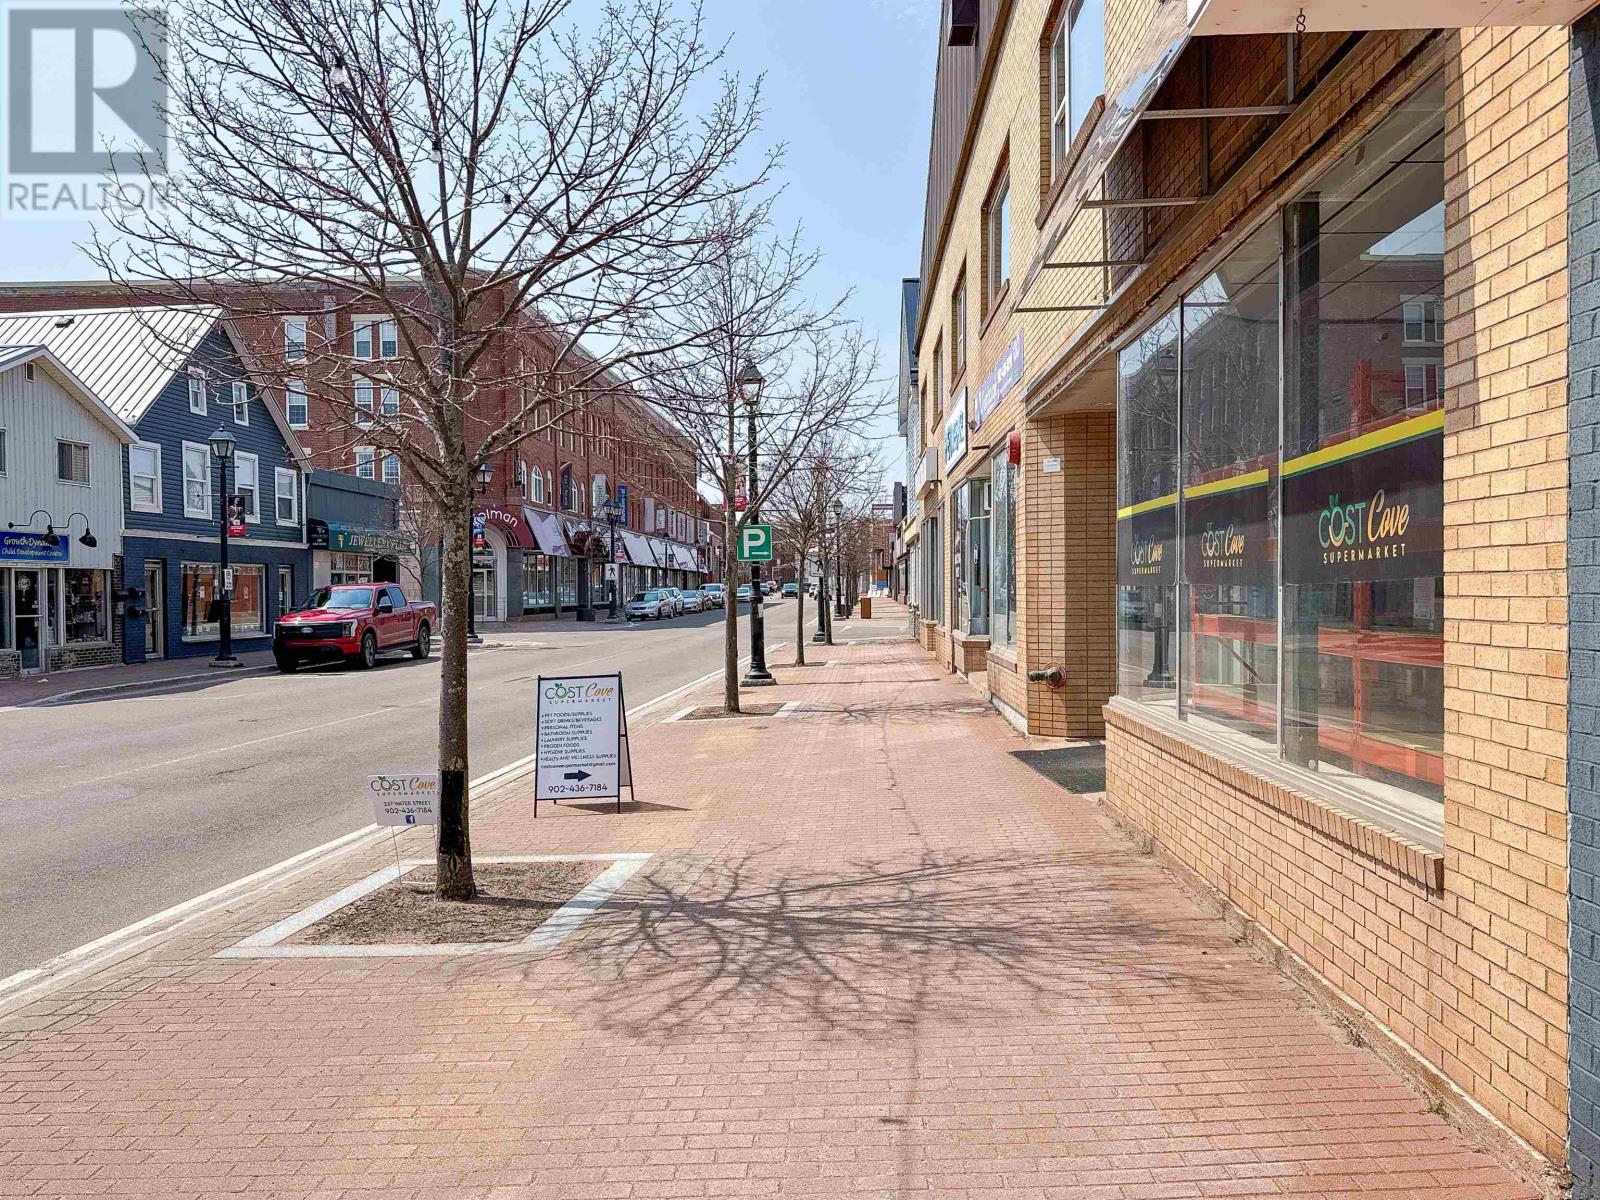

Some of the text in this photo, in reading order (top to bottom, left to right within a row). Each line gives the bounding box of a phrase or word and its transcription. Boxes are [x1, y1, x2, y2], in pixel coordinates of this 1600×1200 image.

[1319, 489, 1410, 548] COST Cove
[4, 537, 28, 545] Growth
[743, 528, 766, 558] P
[1201, 524, 1245, 557] COST Cove
[1130, 538, 1148, 565] COST
[1323, 543, 1406, 564] SUPERMARKET
[1131, 565, 1161, 575] SUPERMARKET
[1203, 558, 1243, 568] SUPERMARKET
[545, 683, 614, 699] COST Cove
[371, 776, 436, 791] COST Cove
[548, 783, 608, 793] 902-436-7184
